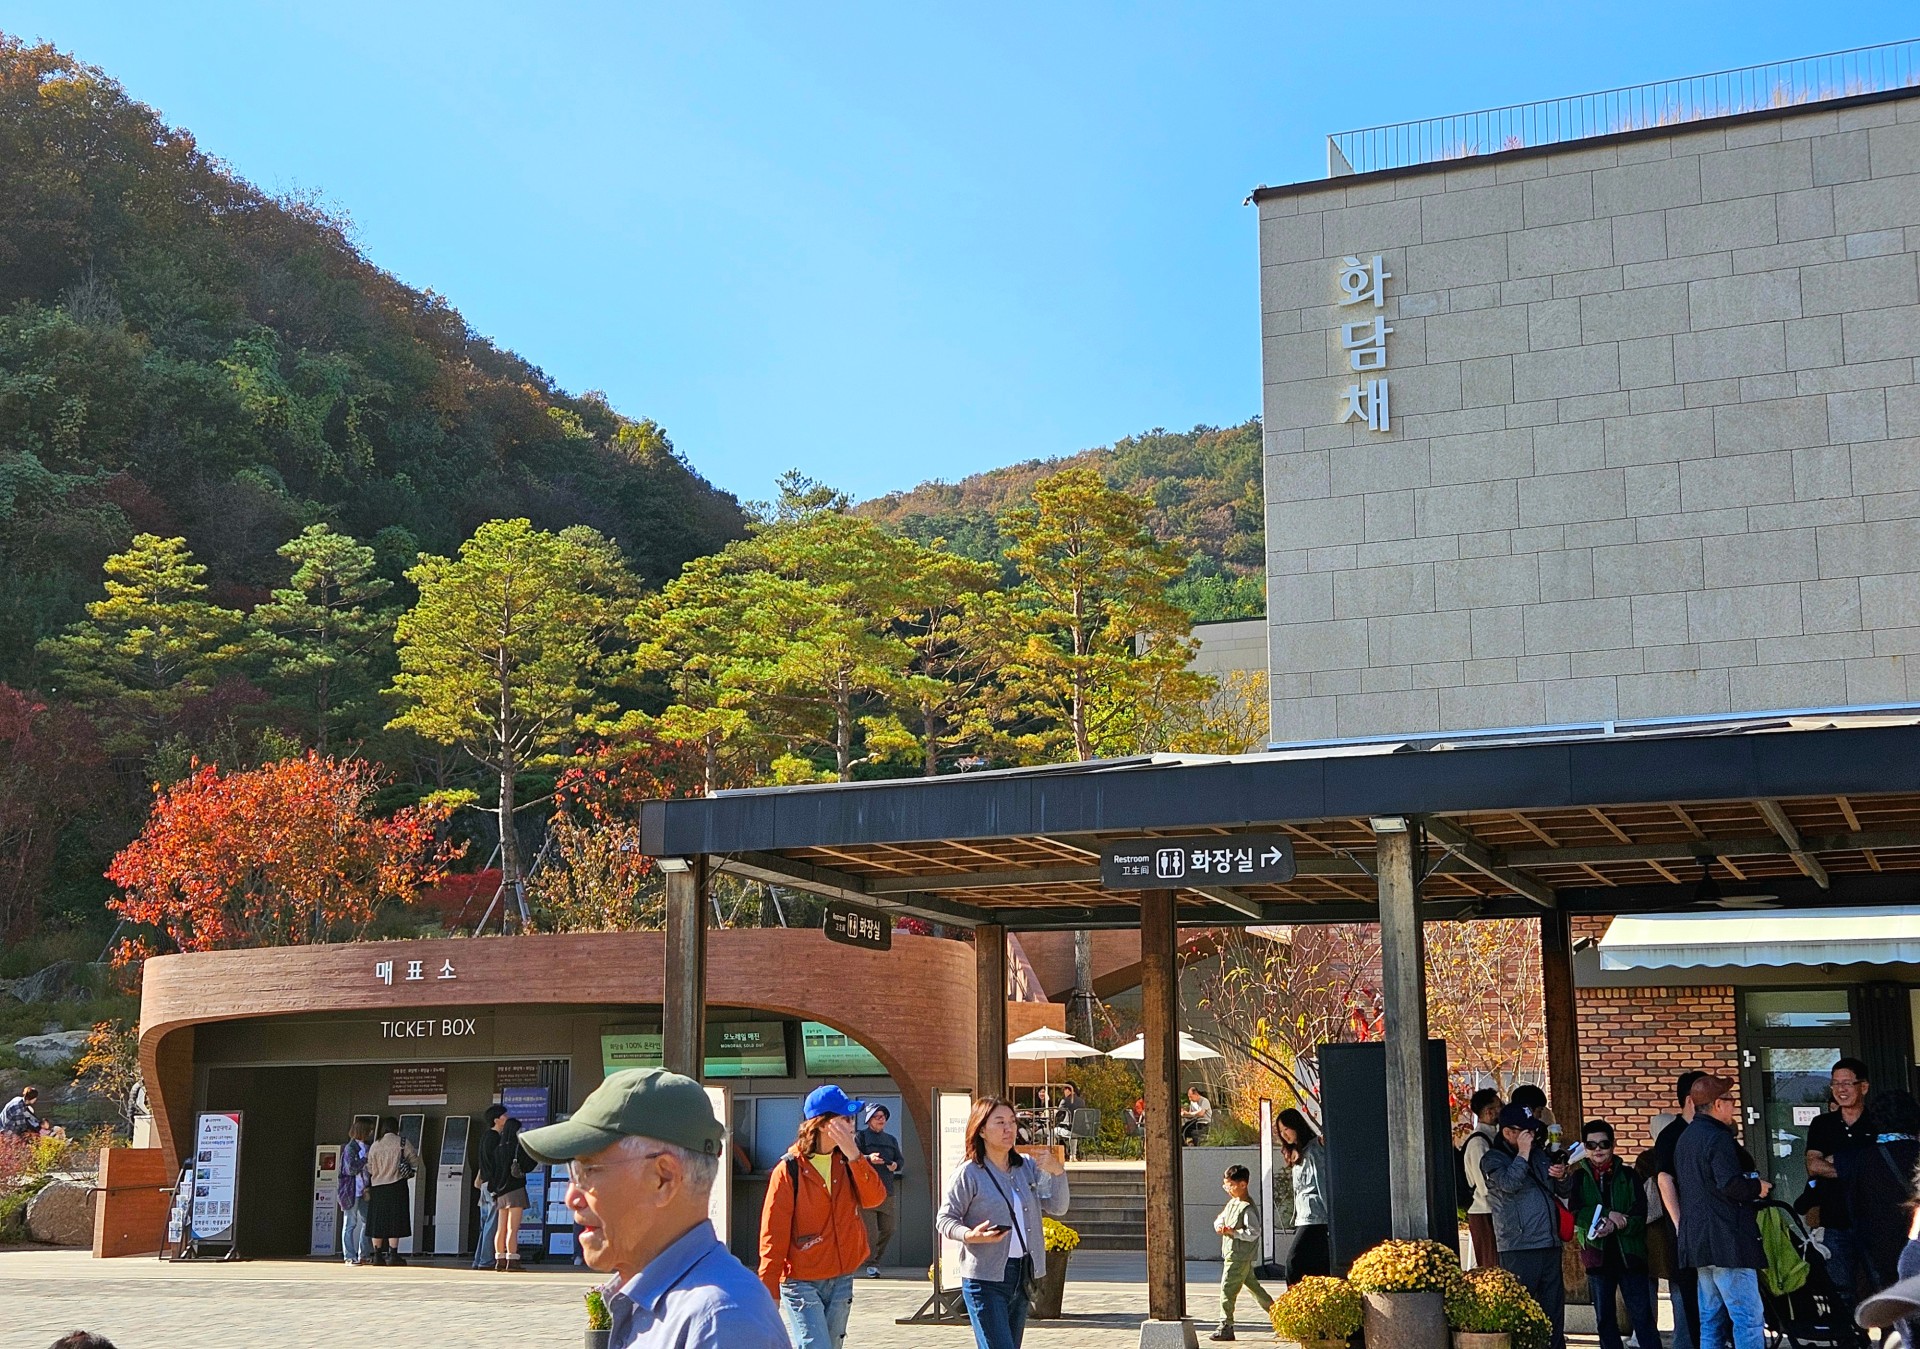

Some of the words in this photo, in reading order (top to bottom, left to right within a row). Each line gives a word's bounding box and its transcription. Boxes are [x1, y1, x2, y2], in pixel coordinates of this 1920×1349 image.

[1338, 254, 1394, 432] 화담채
[1113, 854, 1150, 864] Restroom
[1190, 847, 1254, 874] 화장실
[1121, 865, 1150, 876] 卫生间
[859, 917, 881, 941] 화장실
[380, 1019, 436, 1038] TICKET
[442, 1018, 476, 1036] BOX
[723, 1032, 747, 1041] 모노레일
[747, 1032, 760, 1041] 매진
